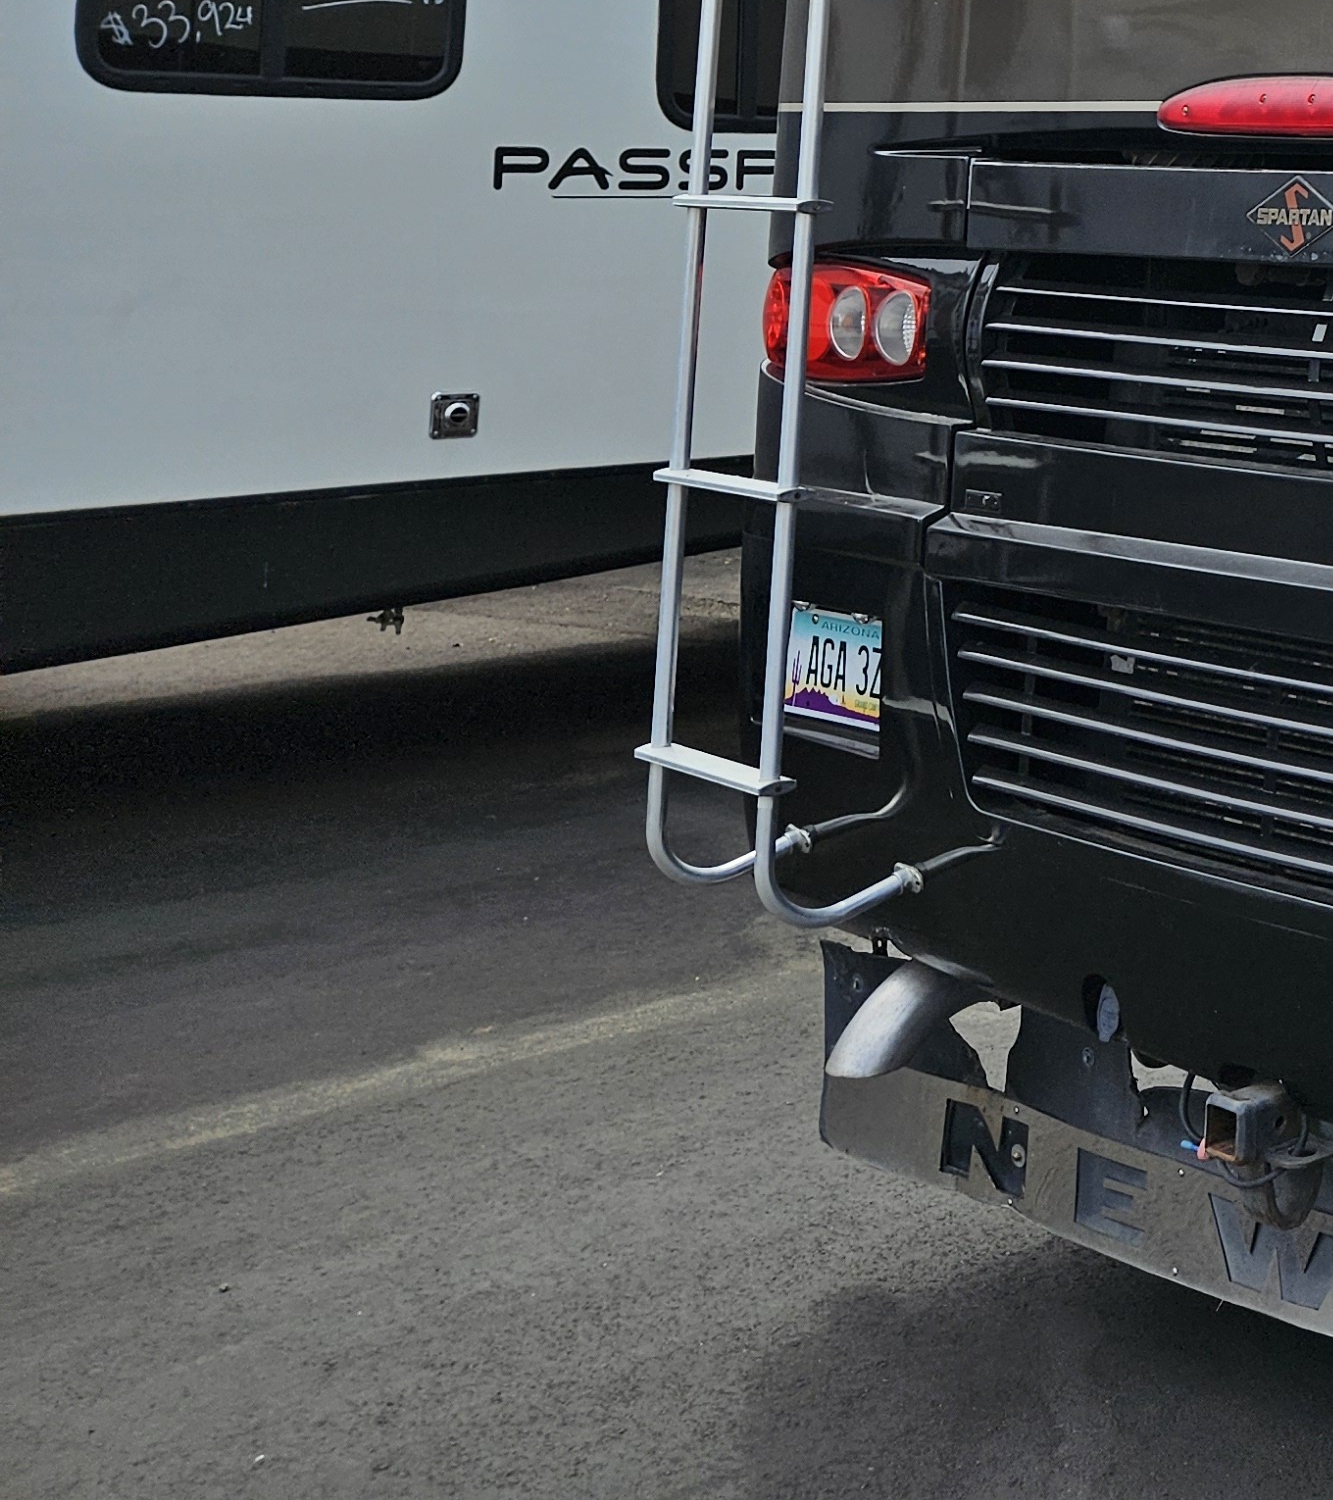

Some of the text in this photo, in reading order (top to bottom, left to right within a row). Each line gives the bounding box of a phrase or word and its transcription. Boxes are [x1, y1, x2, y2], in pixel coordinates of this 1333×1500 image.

[1256, 208, 1333, 226] SPARTAN
[821, 621, 880, 639] ARIZONA
[806, 635, 847, 692] AGA
